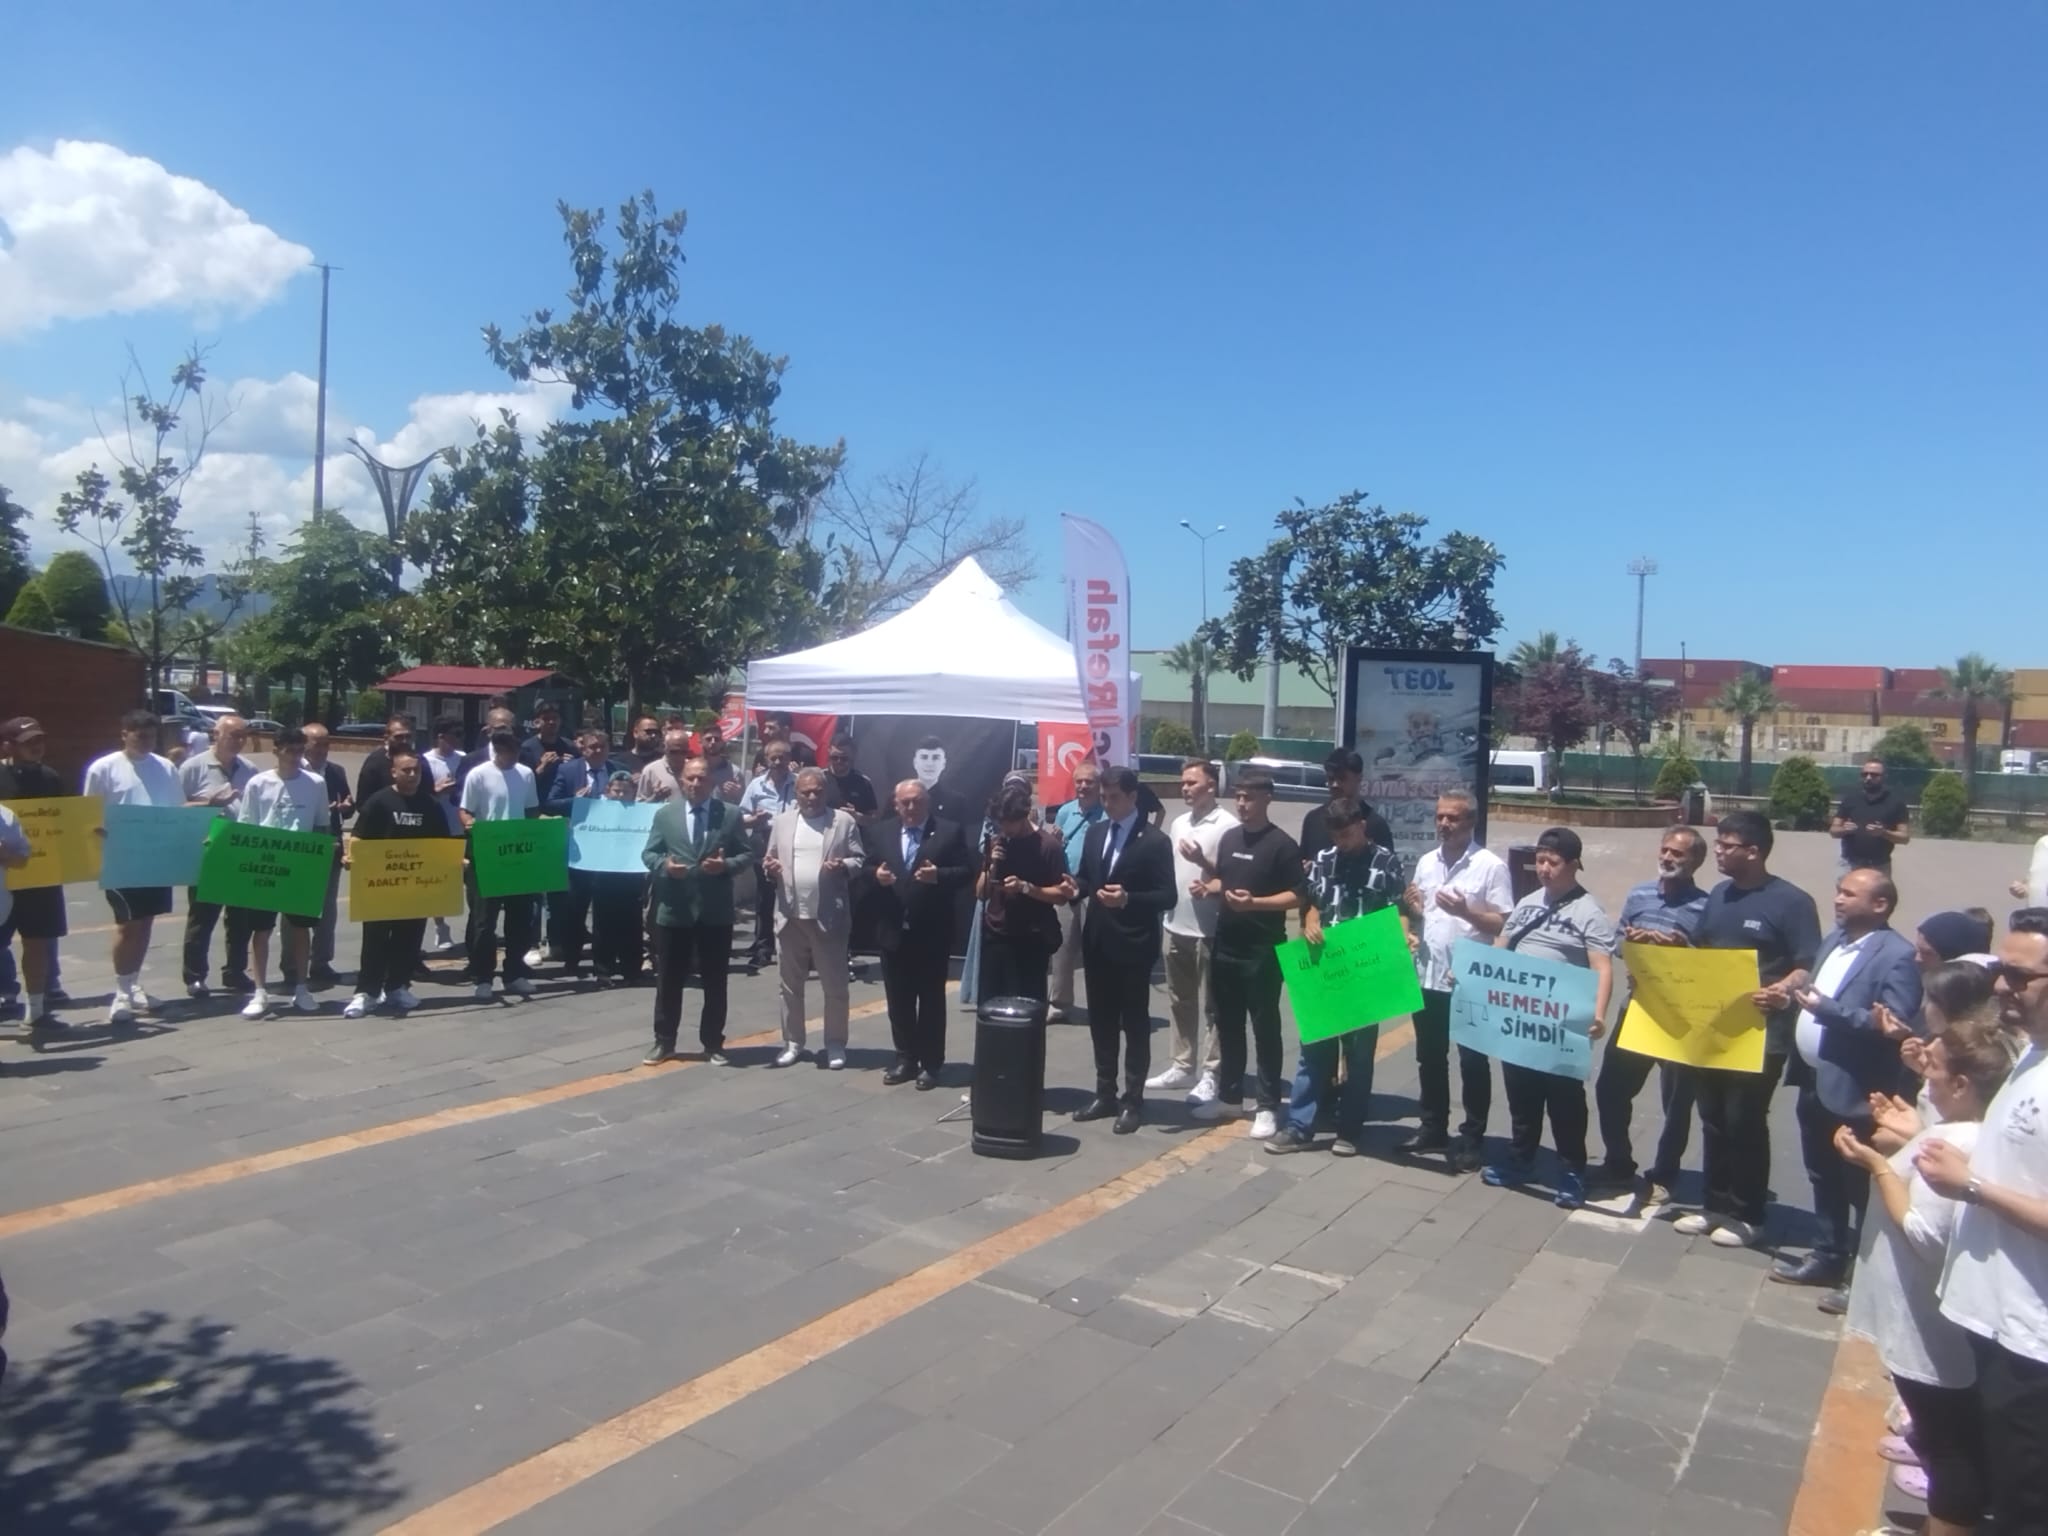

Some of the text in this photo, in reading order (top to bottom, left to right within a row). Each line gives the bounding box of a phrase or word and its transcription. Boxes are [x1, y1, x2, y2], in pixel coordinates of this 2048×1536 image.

[1384, 666, 1455, 690] TEOL
[393, 811, 424, 826] VANS
[1468, 961, 1557, 998] ADALET!
[1487, 989, 1570, 1027] HEMEN!
